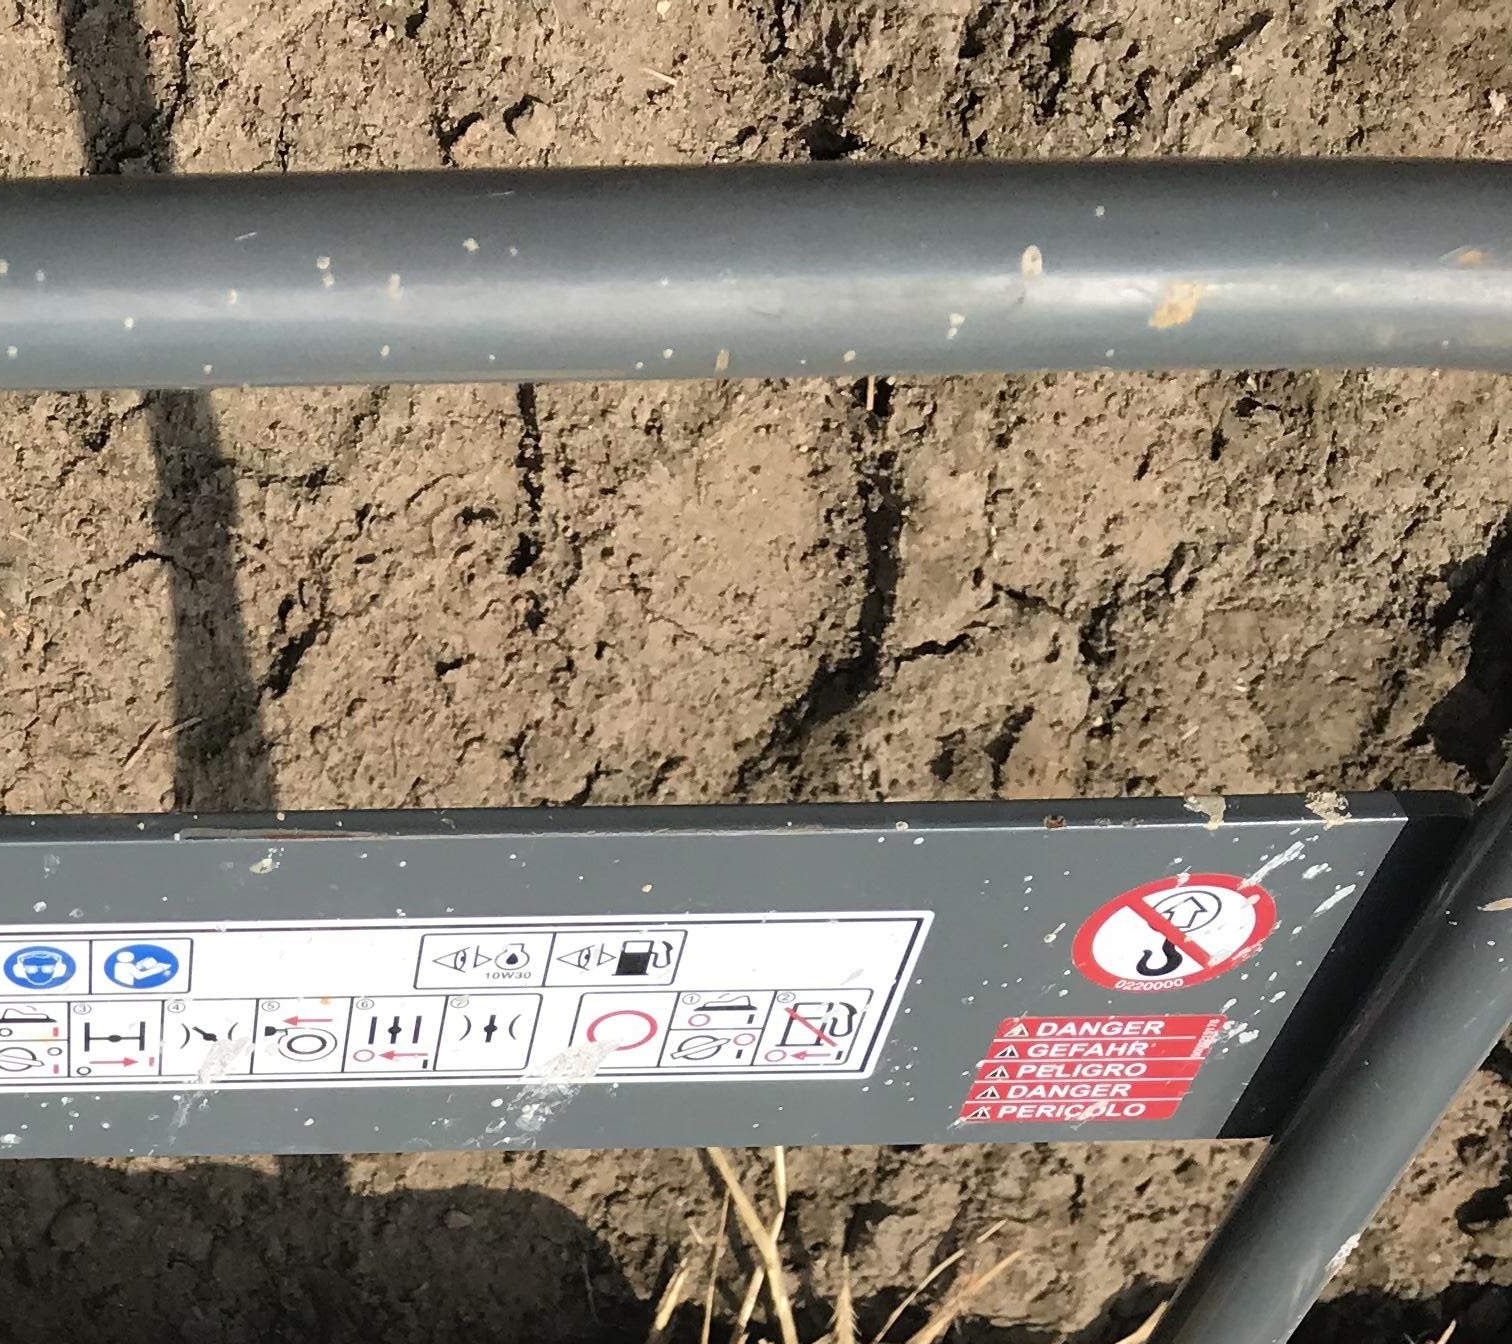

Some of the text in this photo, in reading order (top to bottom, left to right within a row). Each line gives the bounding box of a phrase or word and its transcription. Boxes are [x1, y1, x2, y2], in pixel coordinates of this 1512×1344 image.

[485, 971, 532, 980] 10W30
[1114, 978, 1185, 991] 0220000
[1035, 1020, 1166, 1036] DANGER
[1027, 1042, 1149, 1058] GEFAHR
[1015, 1062, 1148, 1078] PELIGRO
[1006, 1083, 1132, 1099] DANGER
[996, 1103, 1147, 1119] PERICOLO
